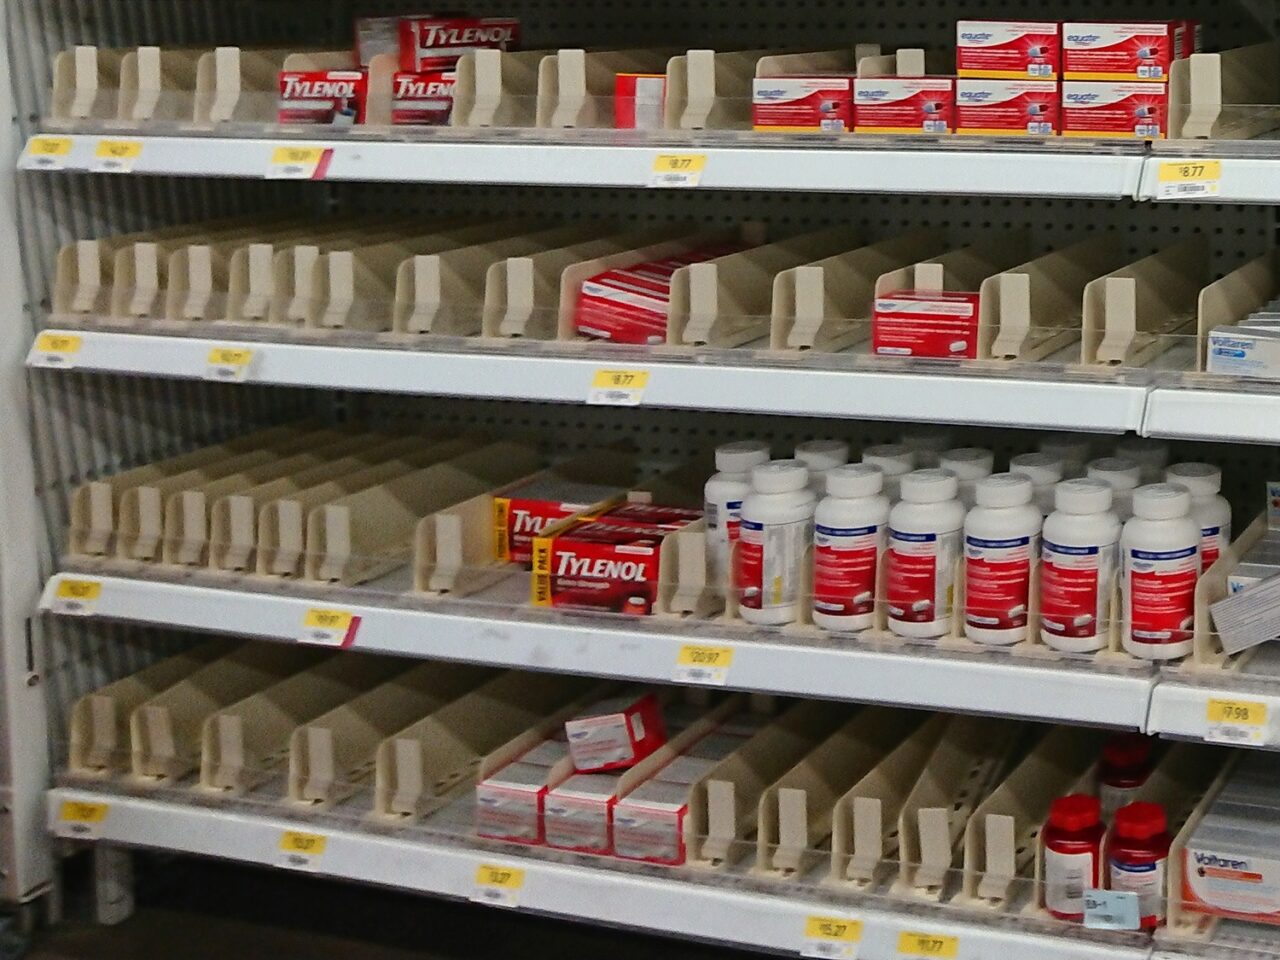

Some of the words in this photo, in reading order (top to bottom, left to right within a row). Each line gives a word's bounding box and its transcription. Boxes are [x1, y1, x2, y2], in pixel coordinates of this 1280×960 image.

[424, 25, 515, 47] TYLENOL
[283, 78, 355, 99] TYLENOL
[396, 78, 455, 98] TYLEN
[538, 547, 548, 571] PACK
[555, 551, 648, 582] TYLENOL
[1194, 851, 1248, 870] Voltaren
